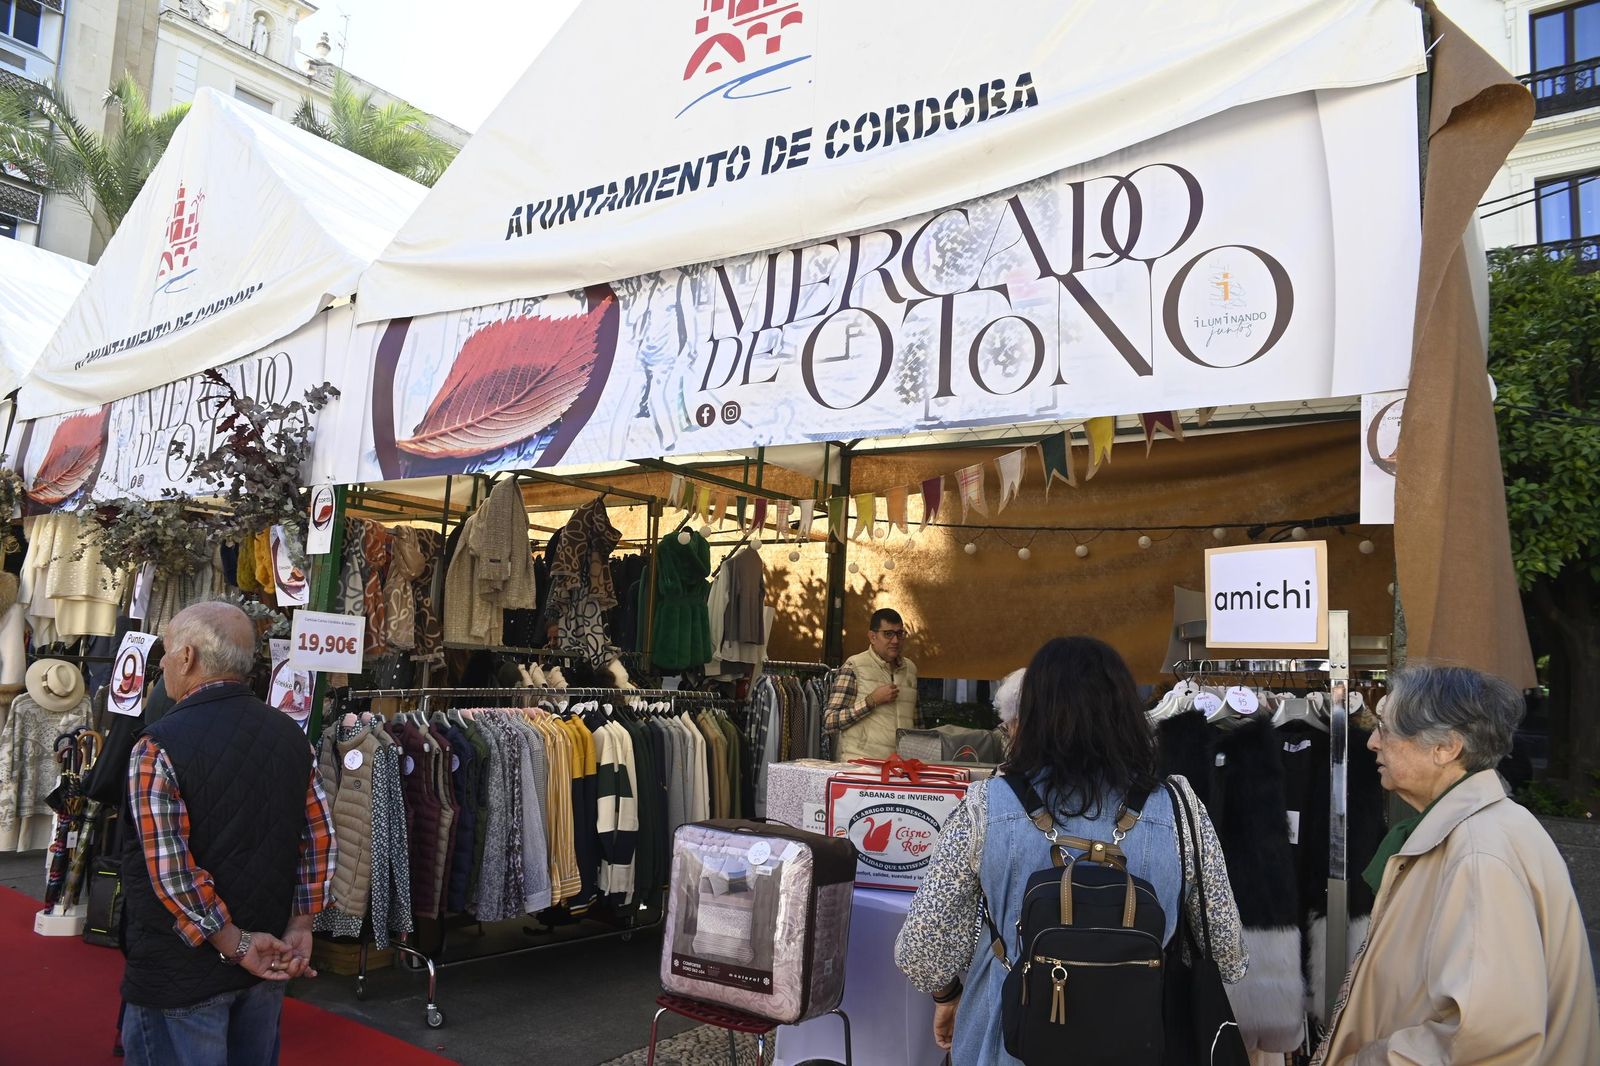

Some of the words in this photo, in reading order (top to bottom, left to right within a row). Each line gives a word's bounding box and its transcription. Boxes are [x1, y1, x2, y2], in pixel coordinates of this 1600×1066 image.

[505, 144, 751, 241] AYUNTAMIENTO
[761, 127, 813, 176] DE
[824, 71, 1040, 160] CORDOBA
[711, 162, 1204, 340] MERCADO
[698, 326, 788, 393] DE
[1215, 579, 1311, 611] amichi
[127, 633, 145, 645] Punto
[298, 632, 358, 655] 19,90€
[859, 790, 896, 800] SABANAS
[907, 793, 945, 803] INVIERNO
[852, 813, 860, 822] EL
[860, 806, 885, 818] ABRIGO
[905, 808, 938, 827] DESCANSO
[895, 826, 932, 840] Cisne
[902, 837, 932, 857] Rojo
[858, 853, 884, 869] CALIDAD
